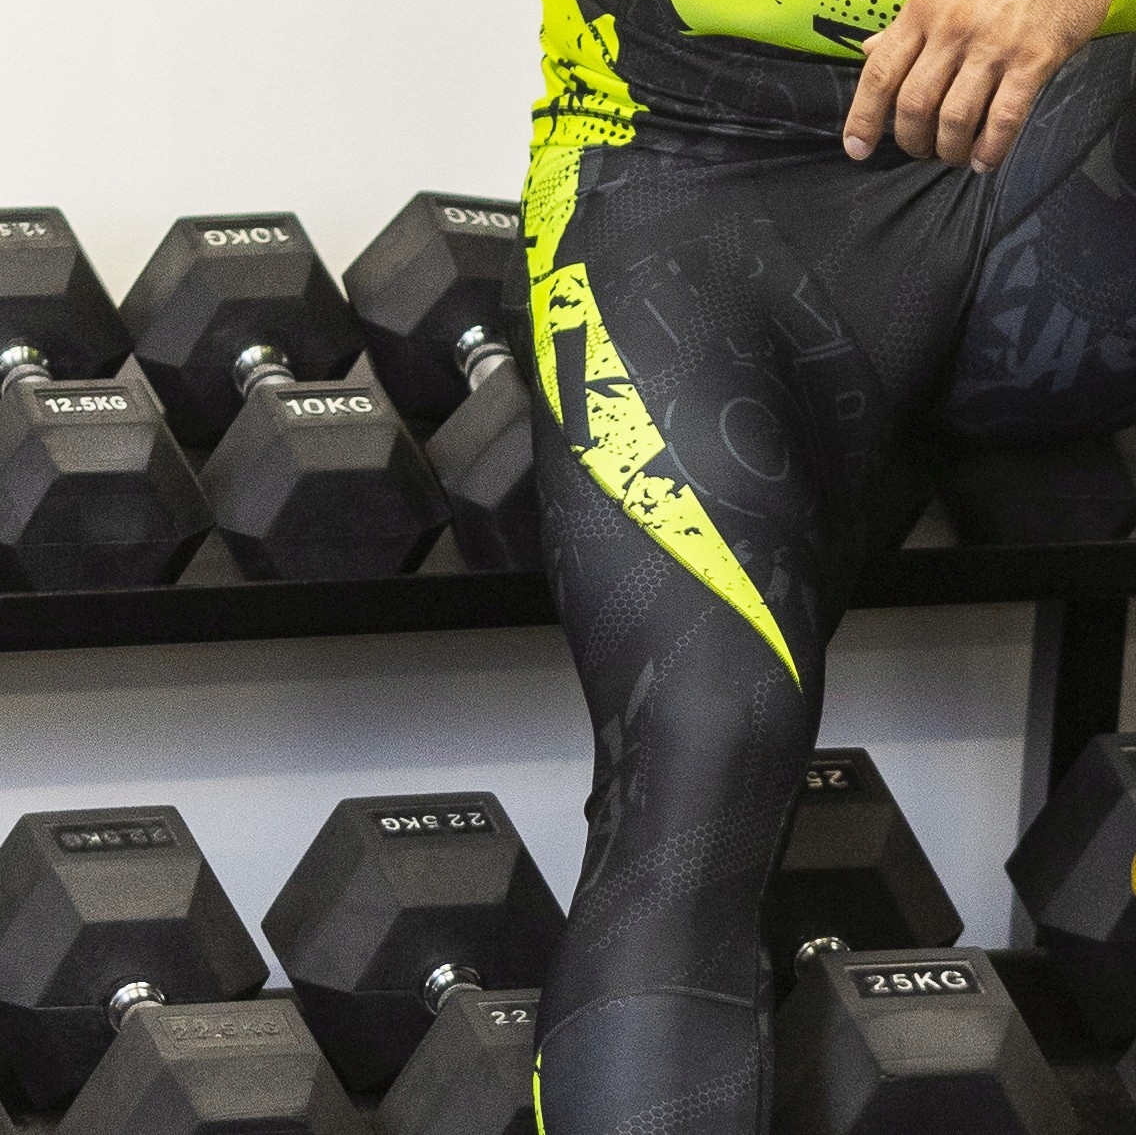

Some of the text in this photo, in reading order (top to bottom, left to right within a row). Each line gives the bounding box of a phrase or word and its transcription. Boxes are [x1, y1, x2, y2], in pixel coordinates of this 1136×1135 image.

[203, 227, 290, 246] 10KG
[44, 395, 128, 413] 12.5KG
[286, 396, 373, 416] 10KG
[381, 812, 486, 831] 225KG
[865, 970, 968, 994] 25KG
